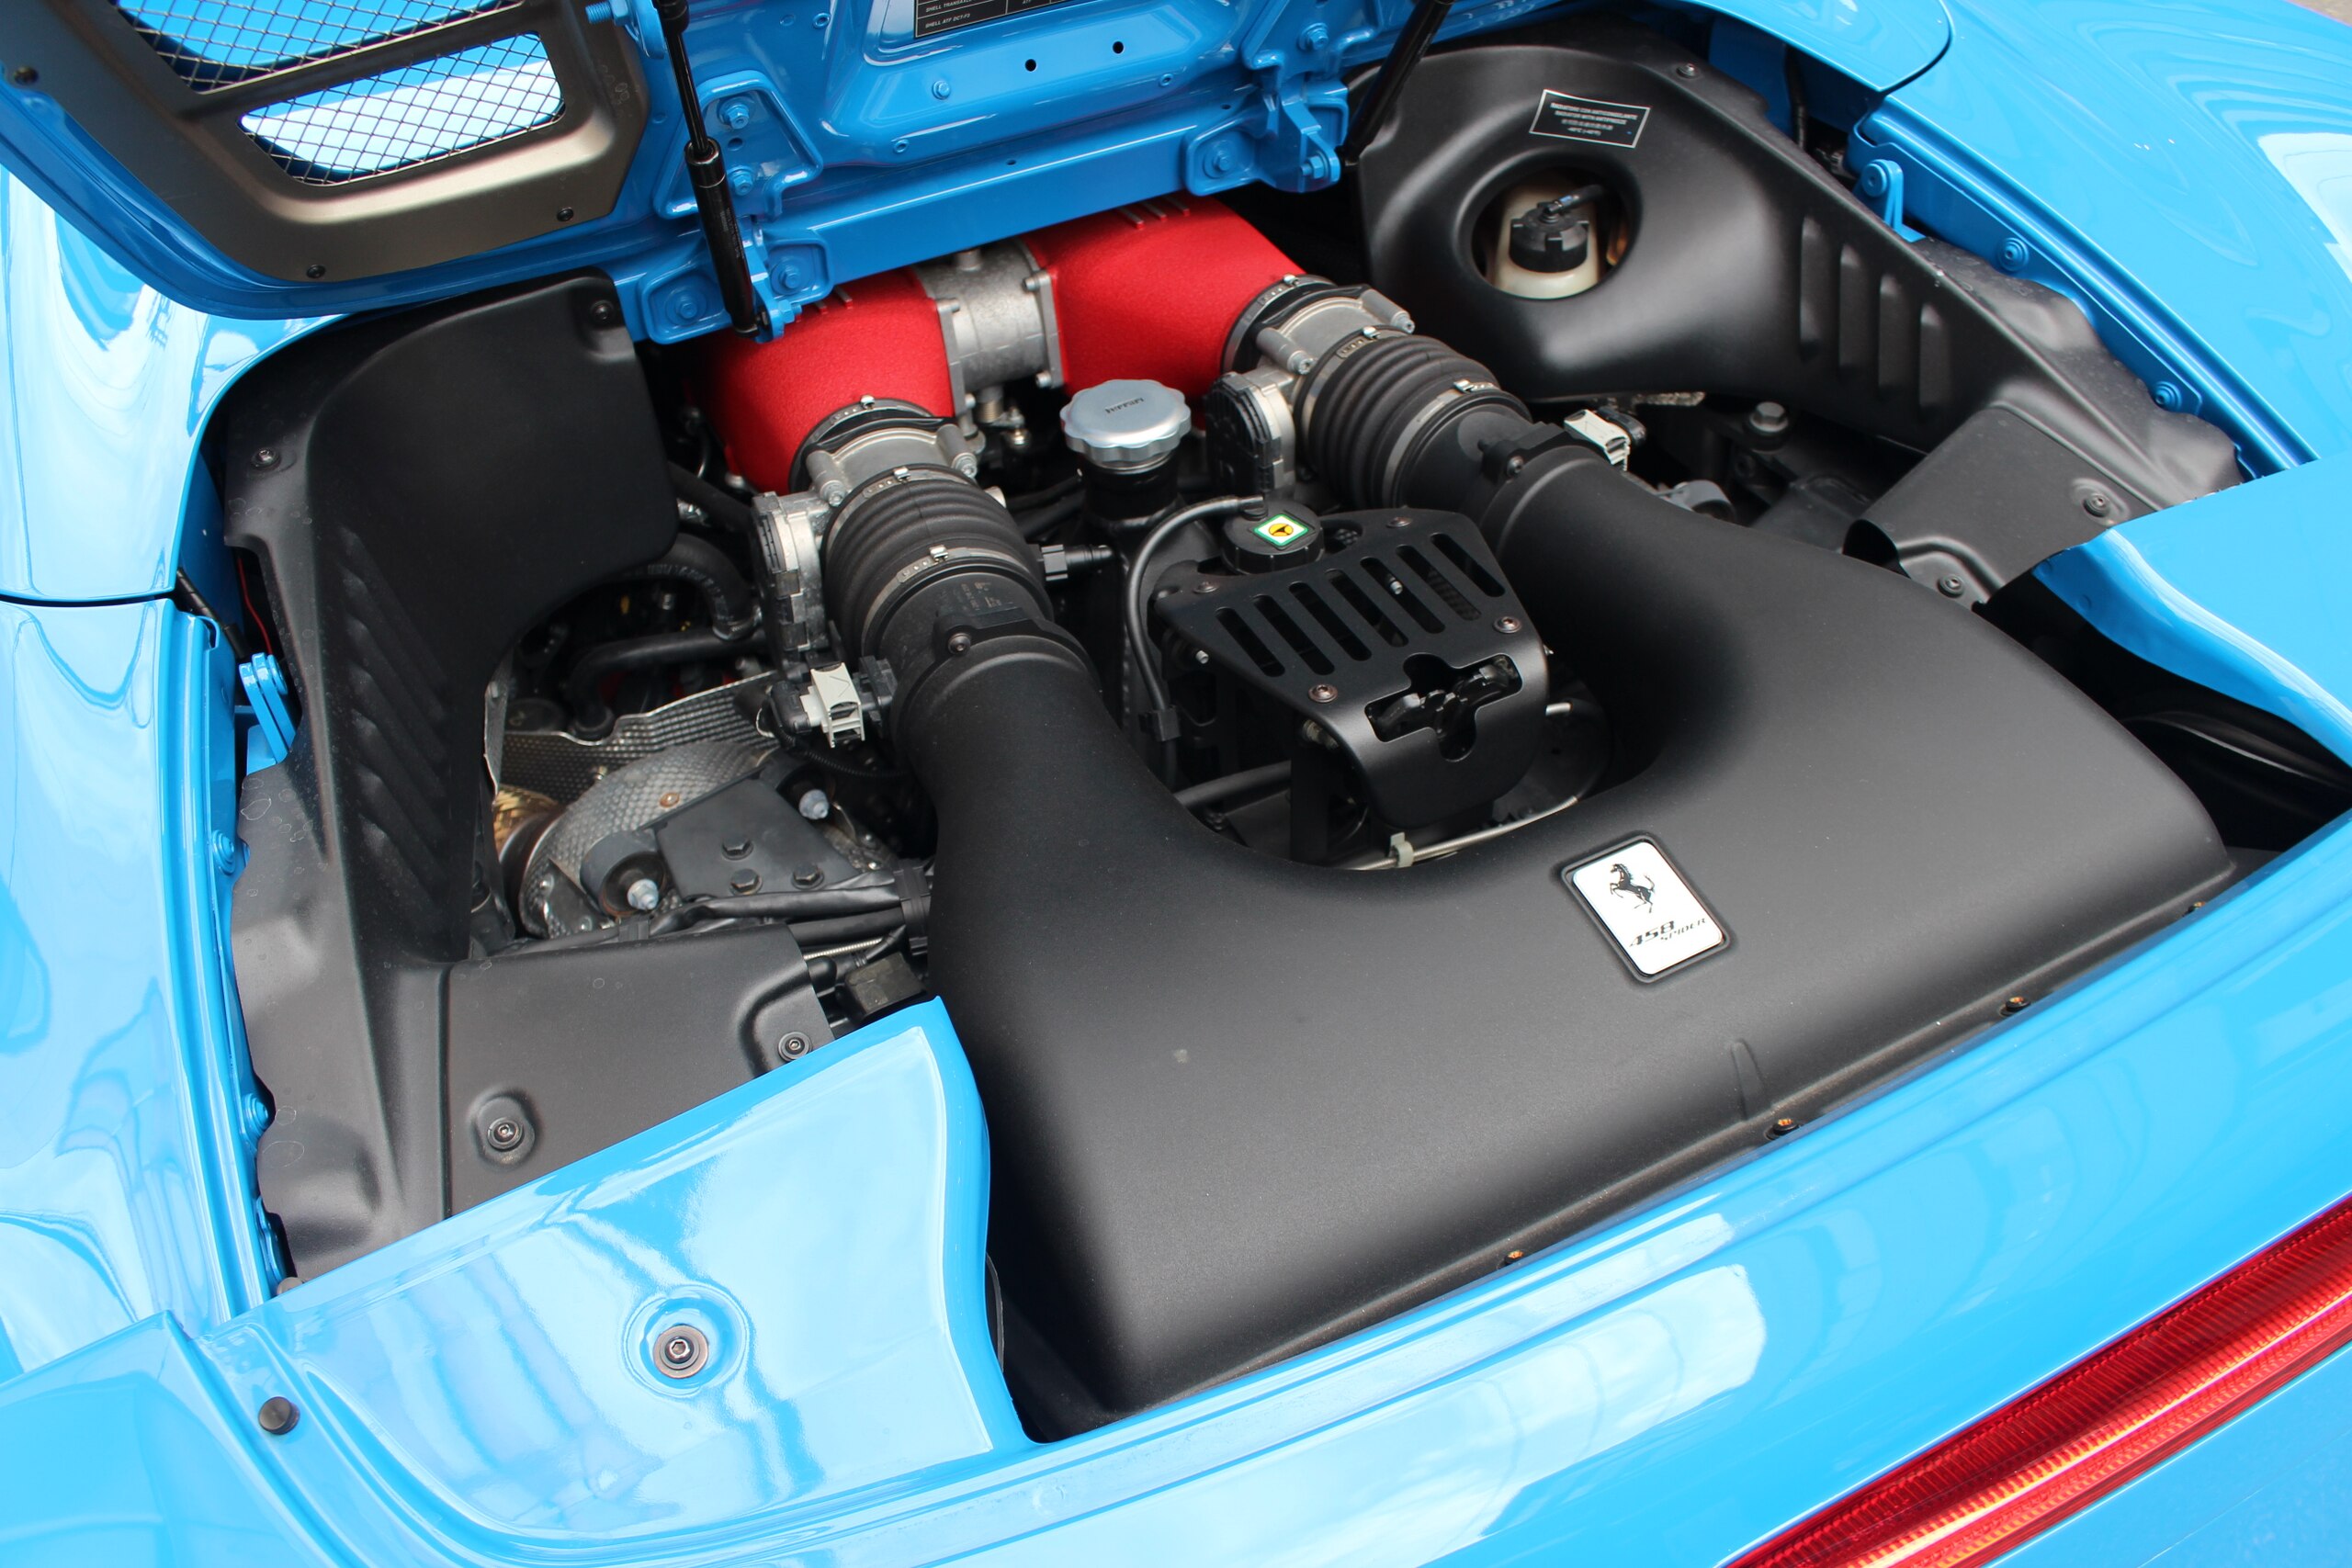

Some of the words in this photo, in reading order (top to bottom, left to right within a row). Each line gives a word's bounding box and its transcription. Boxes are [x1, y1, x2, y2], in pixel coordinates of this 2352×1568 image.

[925, 5, 942, 13] SHELL
[925, 20, 941, 28] SHELL
[1629, 920, 1674, 947] 458
[1660, 918, 1705, 941] SPIDER
